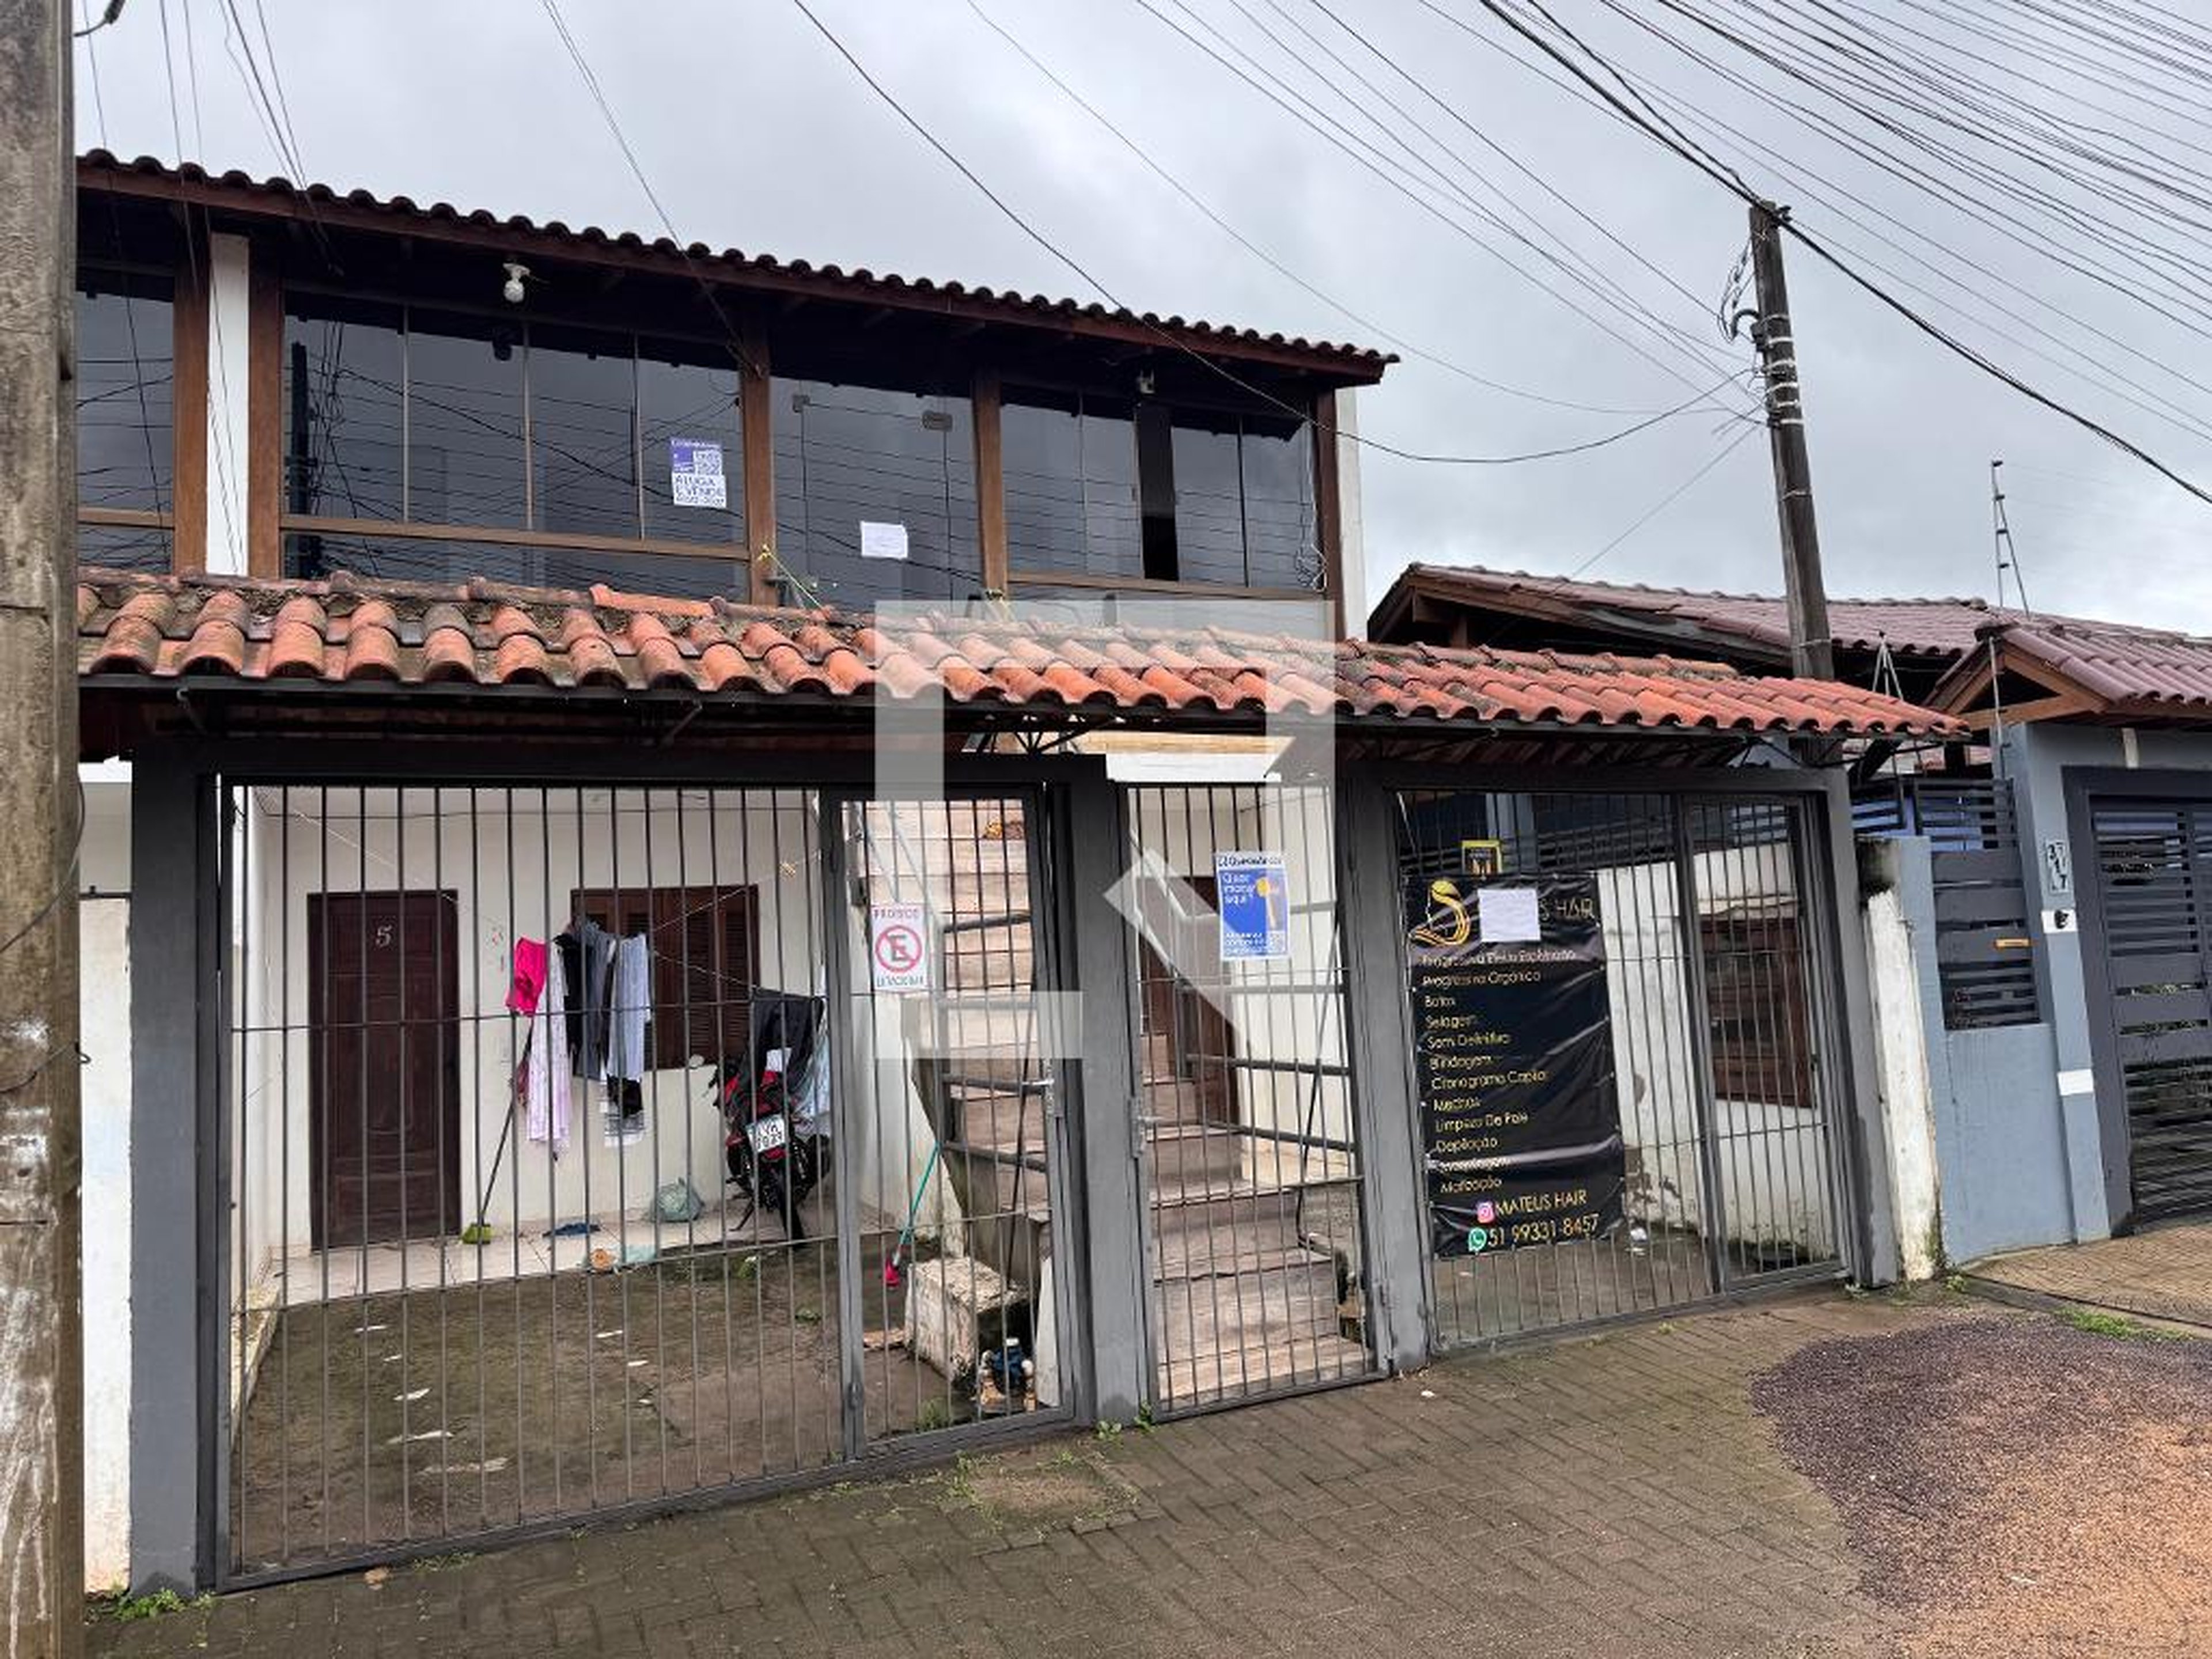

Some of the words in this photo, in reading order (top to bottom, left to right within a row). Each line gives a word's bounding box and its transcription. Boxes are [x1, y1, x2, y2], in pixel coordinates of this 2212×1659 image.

[376, 925, 393, 948] 5
[1495, 1194, 1552, 1215] MATEUS
[1555, 1190, 1587, 1208] HAIR
[1487, 1227, 1505, 1247] 51
[1512, 1219, 1556, 1243] 99331
